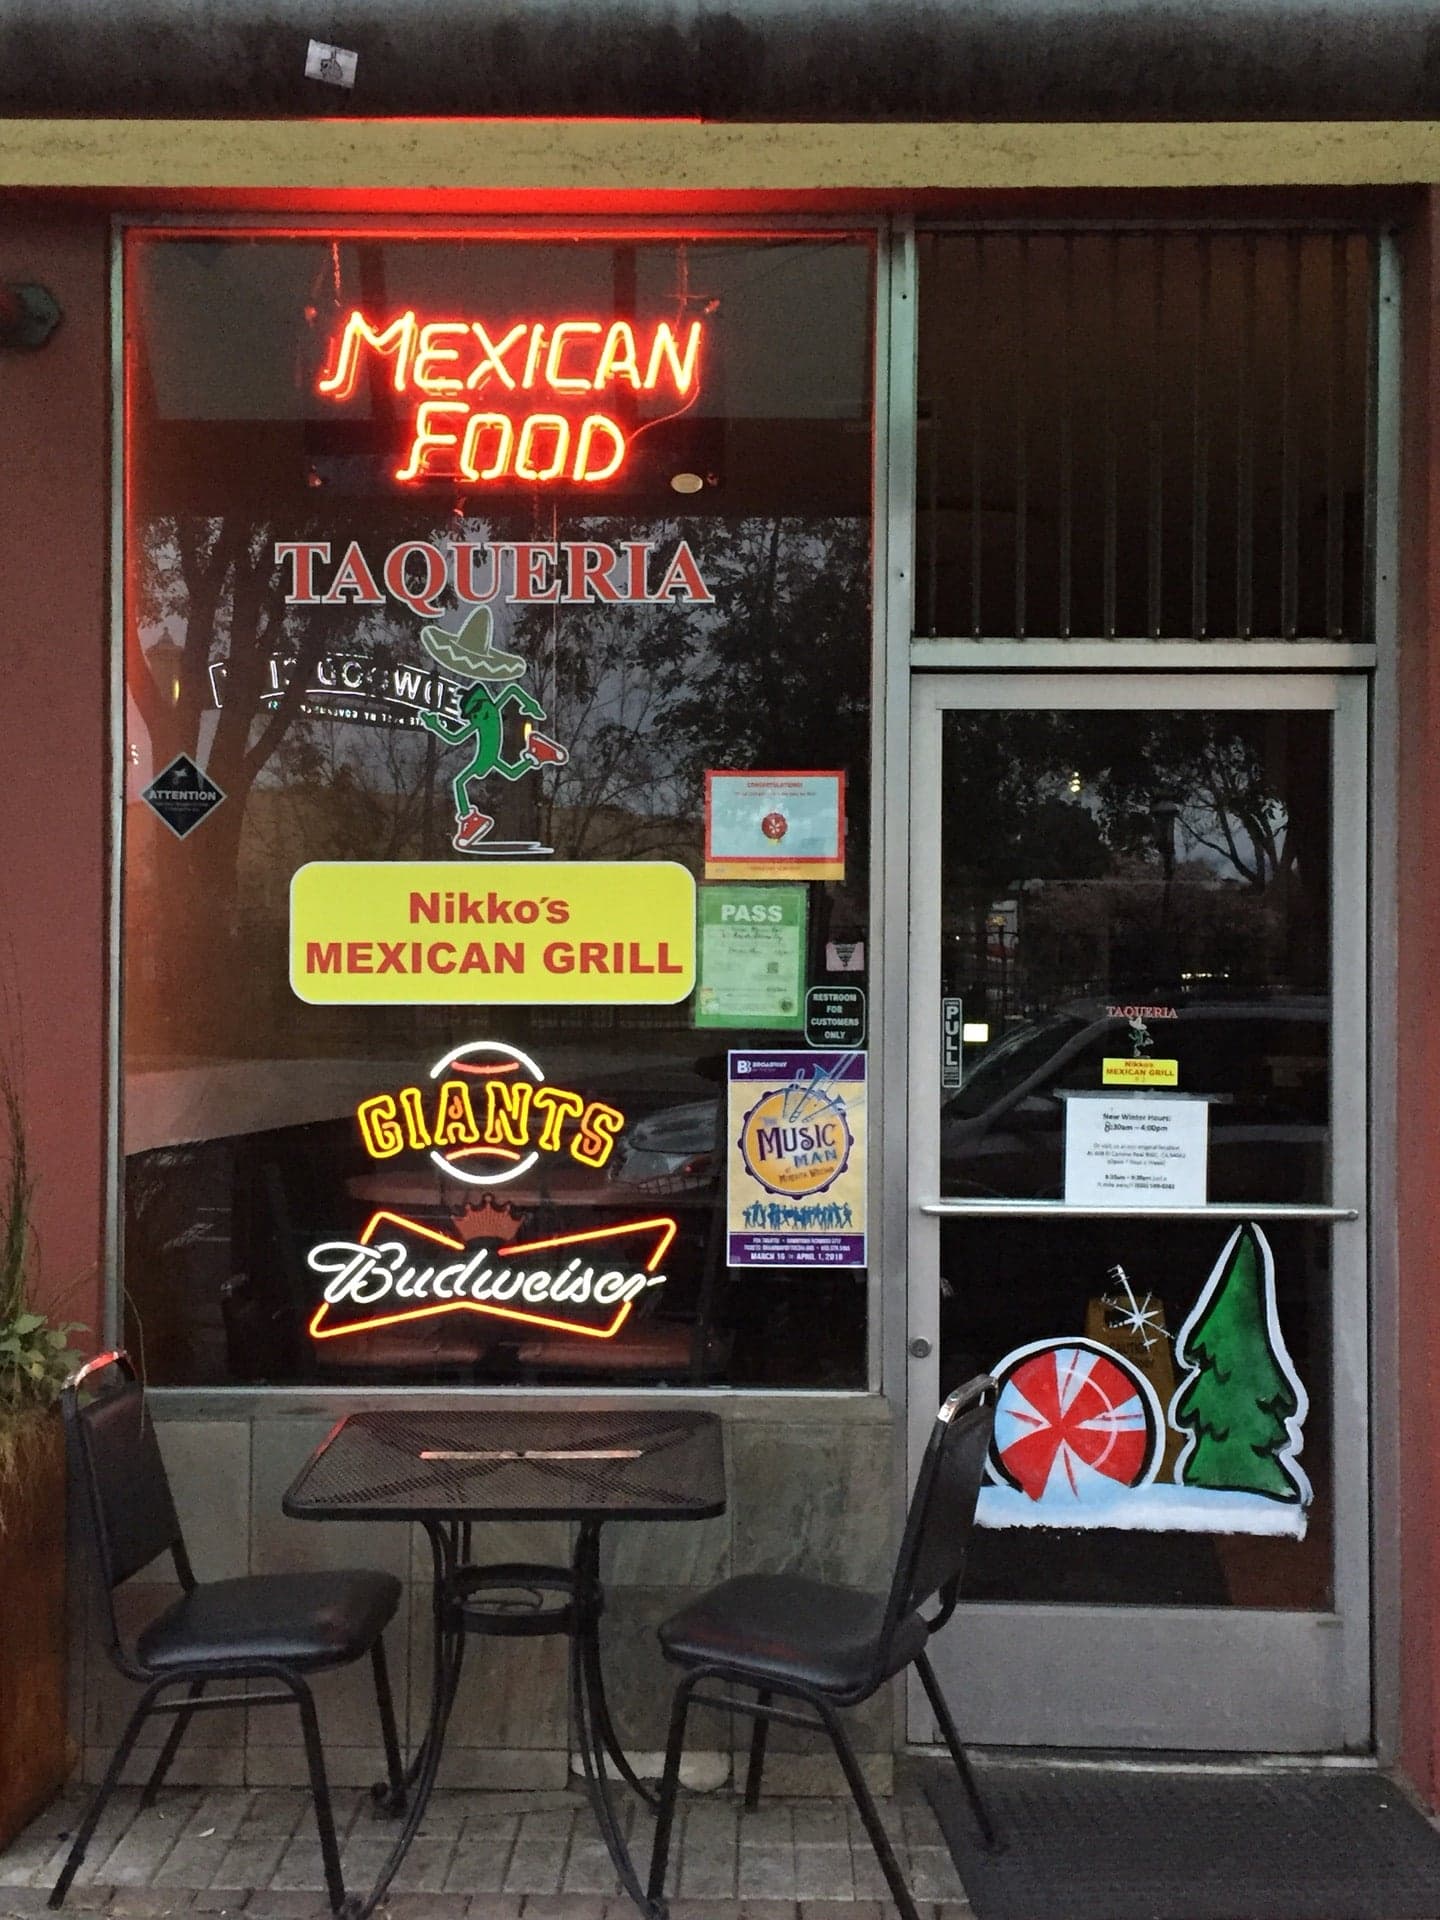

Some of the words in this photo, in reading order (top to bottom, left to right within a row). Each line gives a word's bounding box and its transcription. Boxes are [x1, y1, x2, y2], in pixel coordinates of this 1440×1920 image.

[319, 310, 702, 396] MEXICAN
[396, 401, 626, 482] FOOD
[274, 541, 717, 617] TAQUERIA
[149, 790, 217, 801] ATTENTION
[721, 904, 783, 922] PASS
[306, 942, 525, 974] MEXICAN
[543, 942, 683, 974] GRILL
[813, 993, 857, 1002] RESTROOM
[826, 1005, 843, 1014] FOR
[1106, 1006, 1179, 1019] TAQUERIA
[811, 1017, 860, 1026] CUSTOMERS
[824, 1031, 846, 1040] ONLY
[945, 1005, 960, 1066] PULL
[1106, 1068, 1146, 1076] MEXICAN
[1149, 1069, 1175, 1077] GRILL
[357, 1080, 625, 1168] GIANTS
[756, 1124, 837, 1161] MUSIC
[793, 1150, 838, 1168] MAN
[307, 1242, 667, 1304] Budweiser
